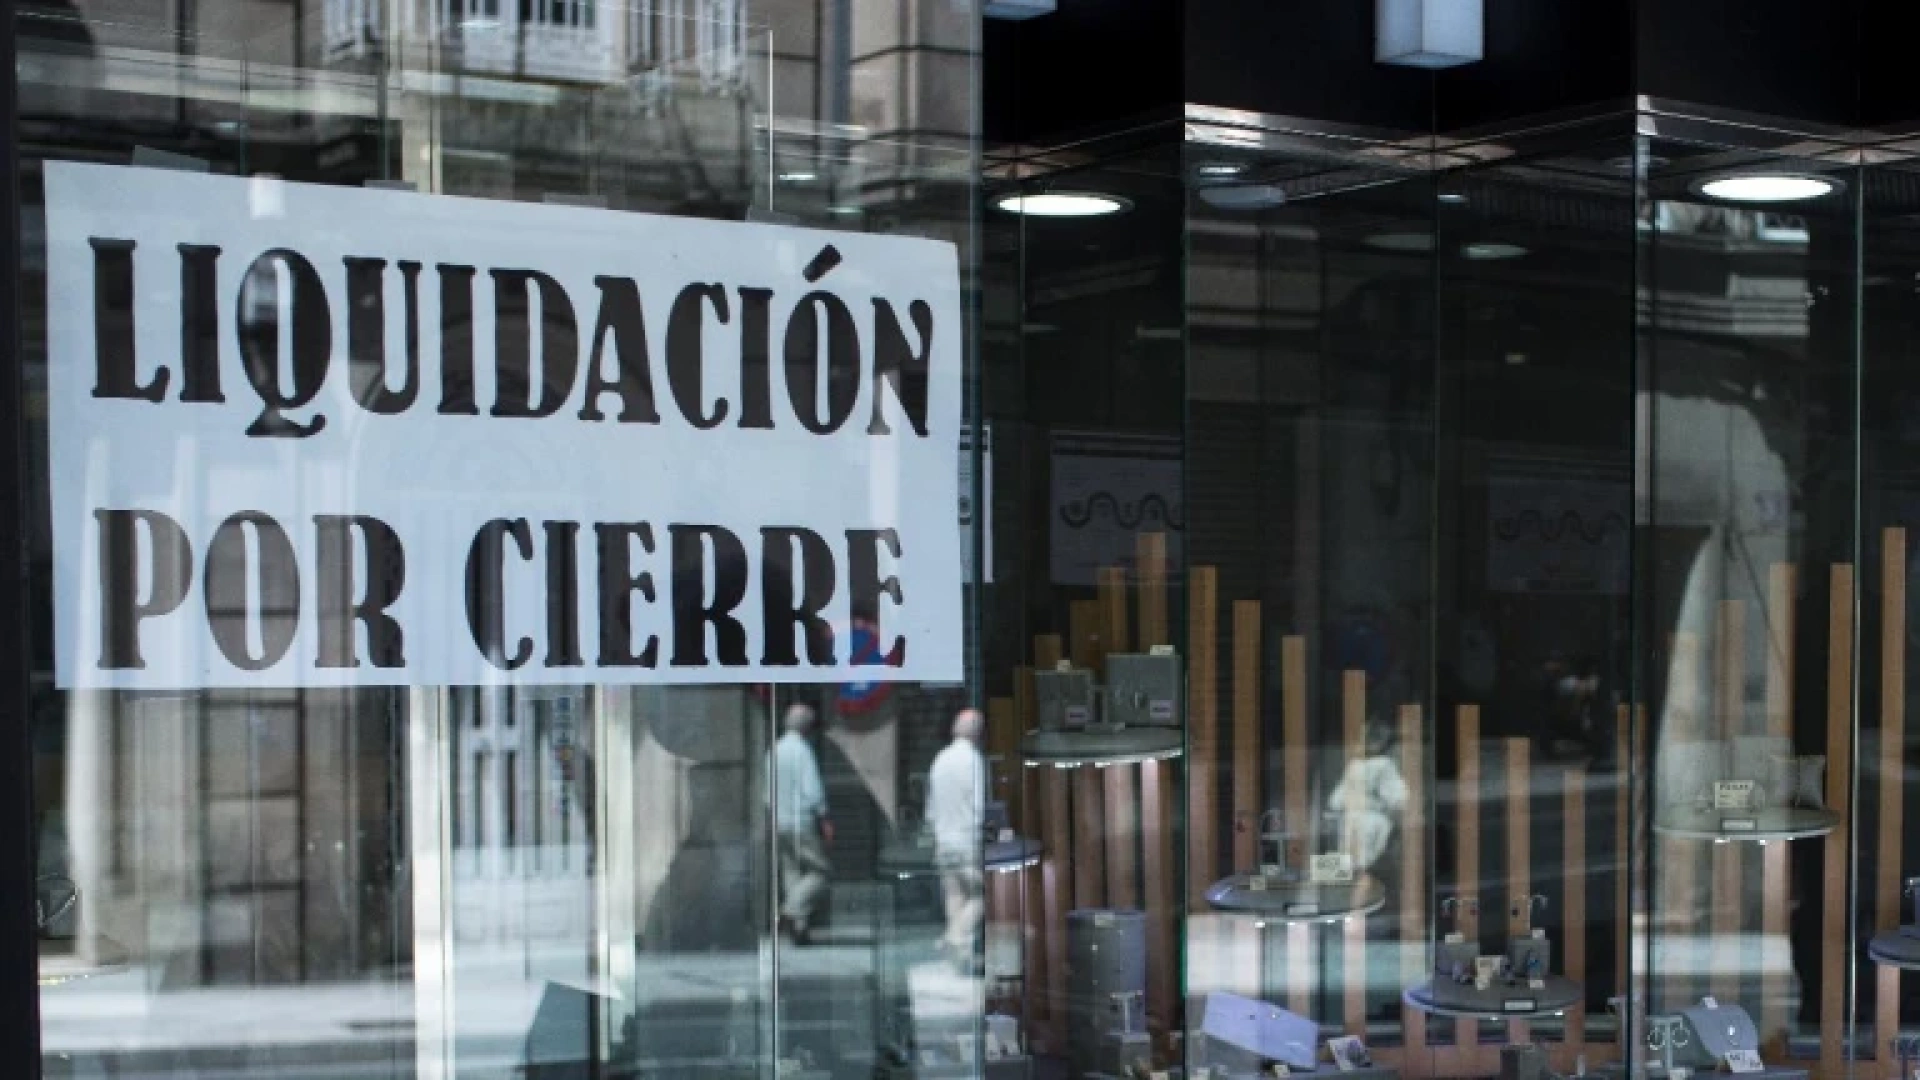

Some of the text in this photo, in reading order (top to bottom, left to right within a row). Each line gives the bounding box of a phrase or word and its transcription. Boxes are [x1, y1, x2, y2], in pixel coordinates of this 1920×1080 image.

[88, 237, 934, 439] LIQUIDACIÓN
[94, 509, 907, 671] POR CIERRE
